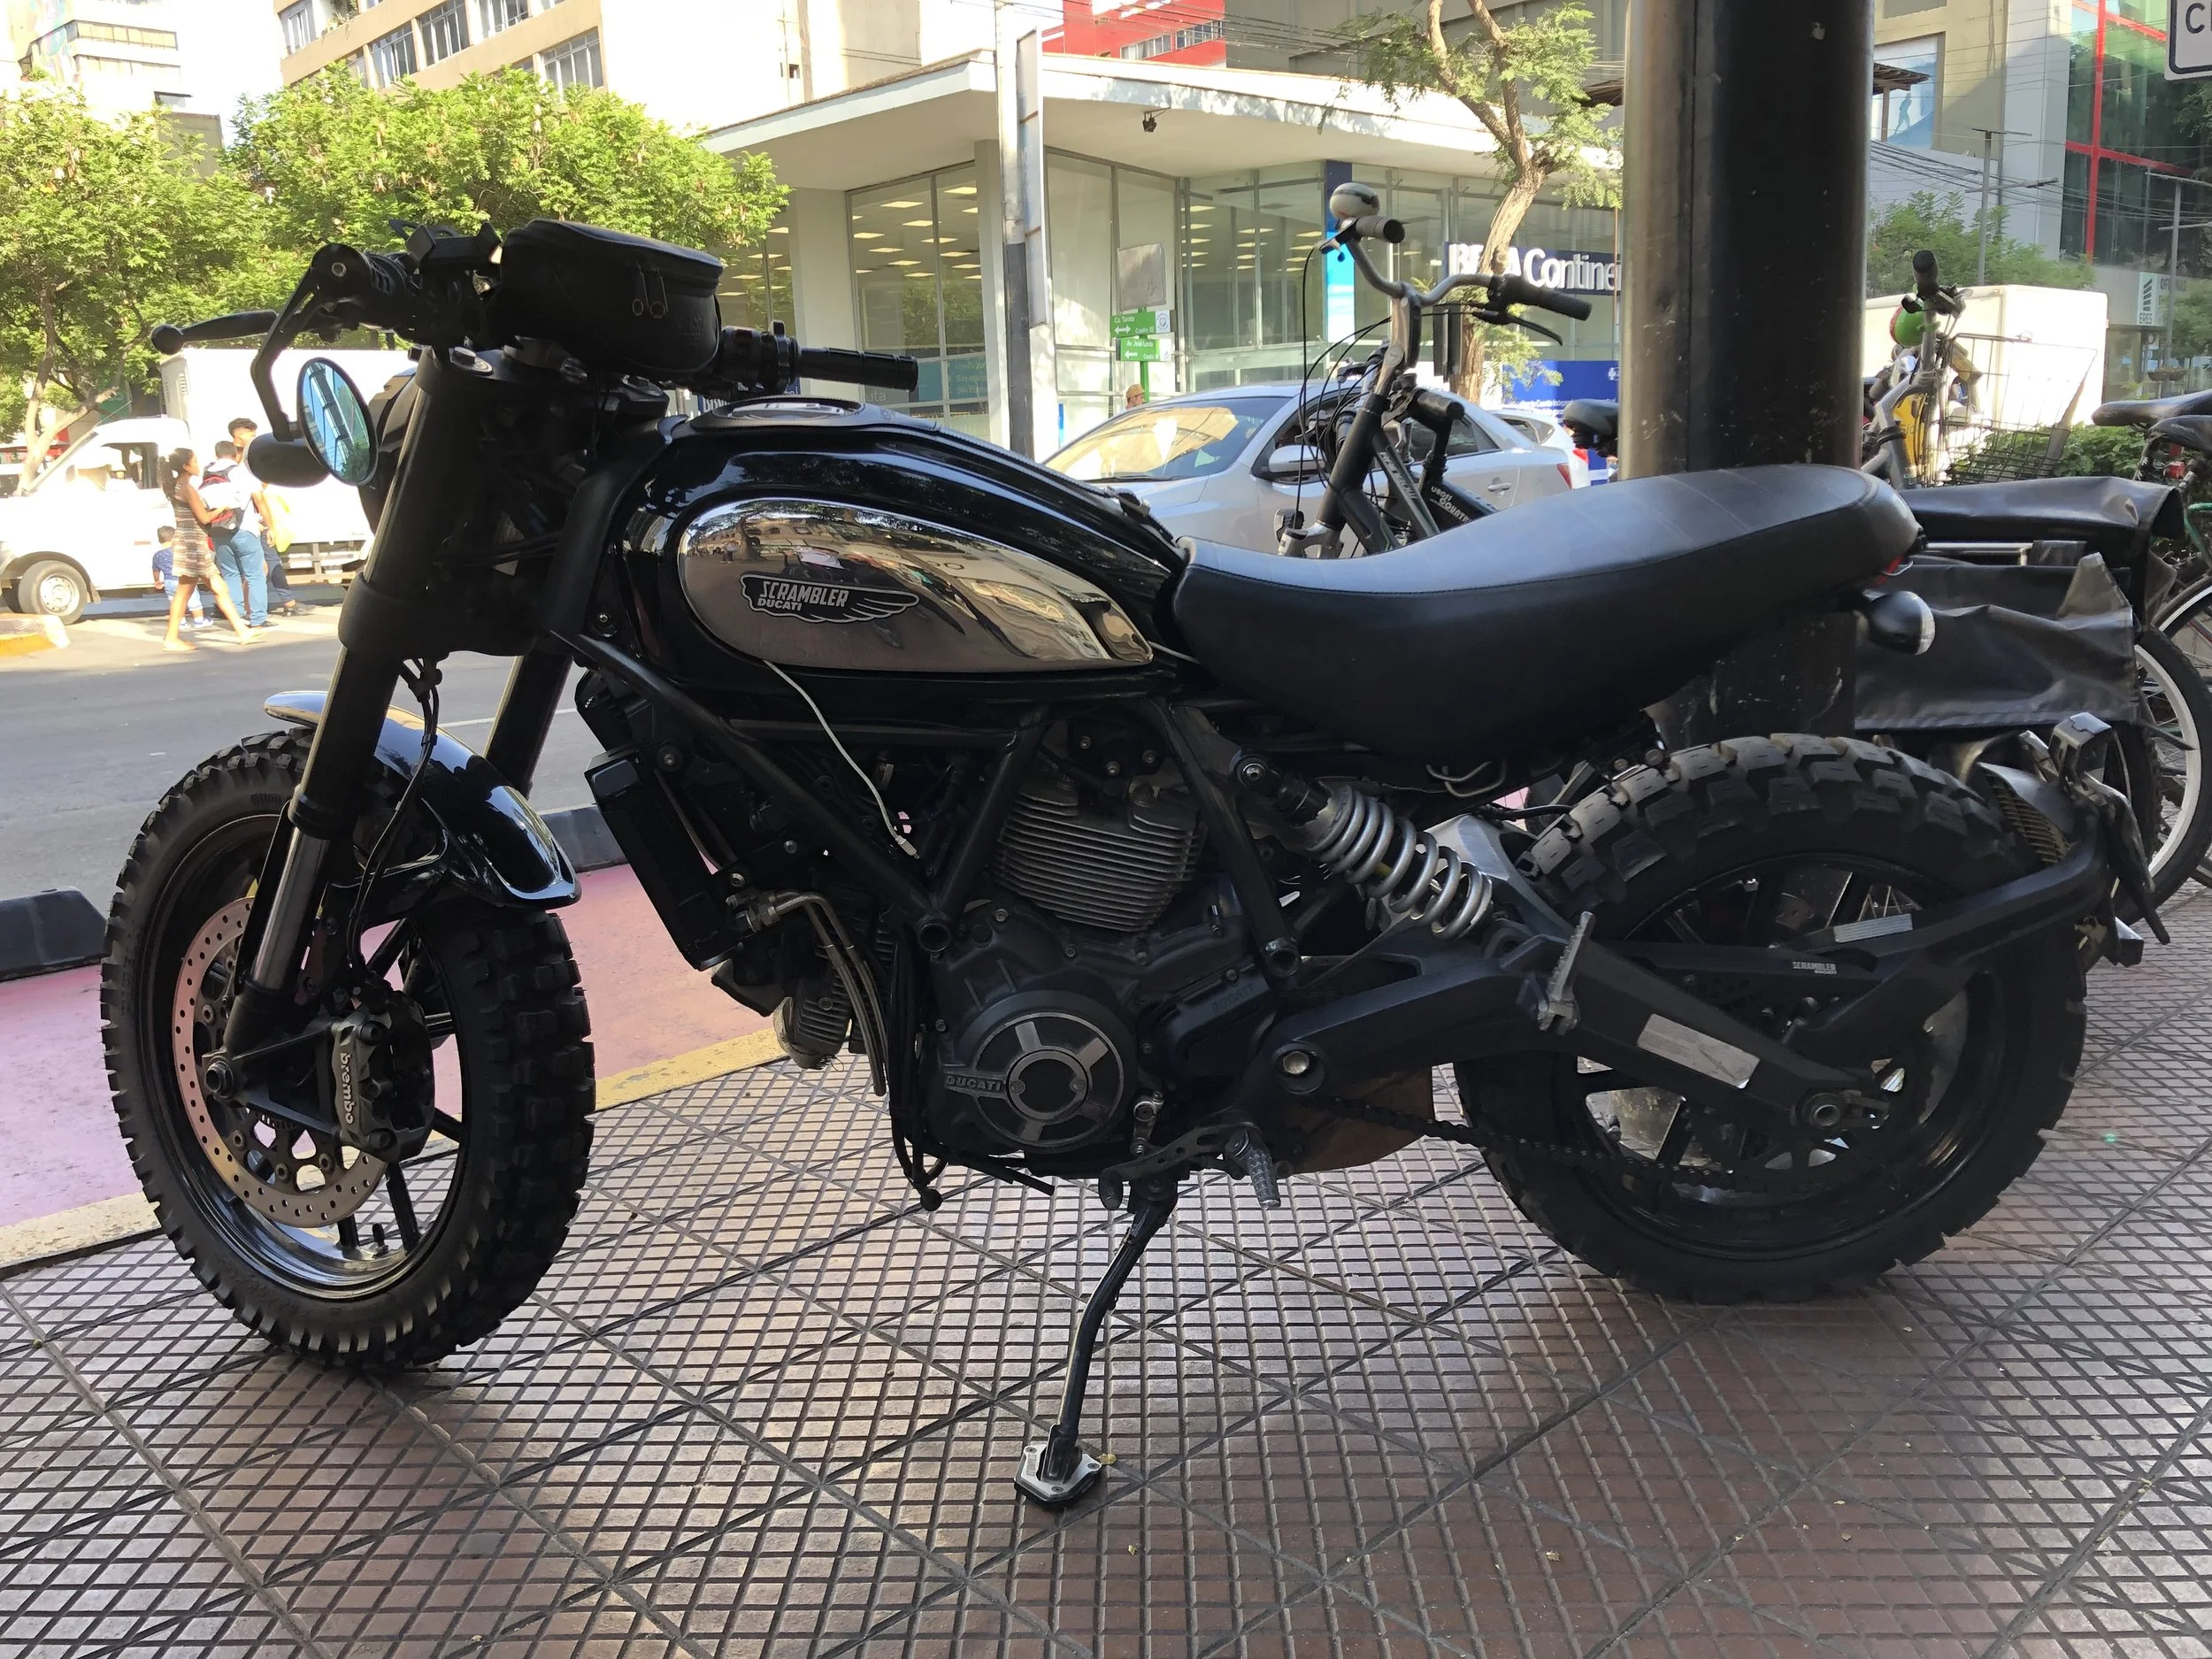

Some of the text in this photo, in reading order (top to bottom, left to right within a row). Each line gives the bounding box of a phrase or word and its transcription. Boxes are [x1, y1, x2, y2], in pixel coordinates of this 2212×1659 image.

[2185, 3, 2212, 34] C
[1523, 248, 1621, 291] Contine
[757, 597, 802, 611] DUCATI
[759, 580, 849, 608] SCRAMBLER
[340, 1052, 355, 1125] brembo
[946, 1075, 1002, 1091] DUCATI
